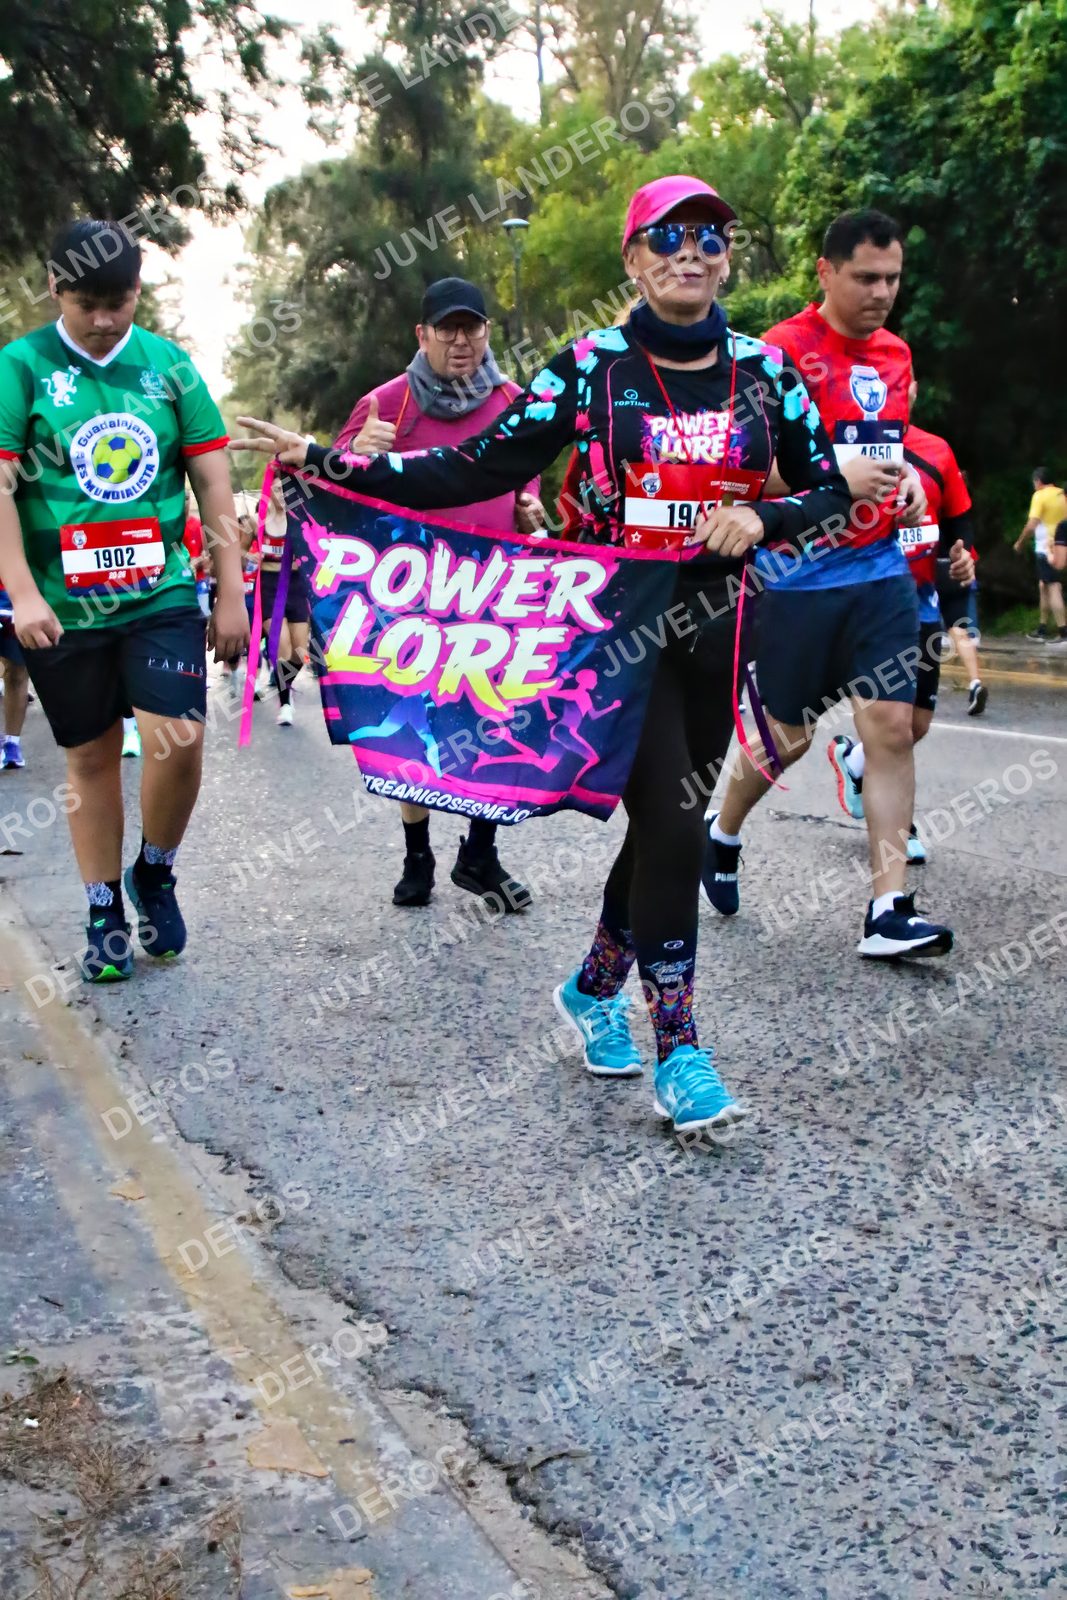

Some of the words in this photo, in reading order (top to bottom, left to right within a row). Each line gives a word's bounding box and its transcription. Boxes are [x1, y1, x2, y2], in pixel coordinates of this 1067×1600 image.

[613, 400, 650, 408] TOPTIME
[77, 418, 152, 447] Guadalajara
[83, 463, 155, 500] MUNDIALISTA
[667, 502, 718, 528] 19
[94, 546, 136, 570] 1902
[315, 537, 606, 630] POWER
[147, 656, 204, 677] PARIS
[323, 593, 570, 713] LORE
[361, 773, 541, 824] TREAMIGOSESMEJO
